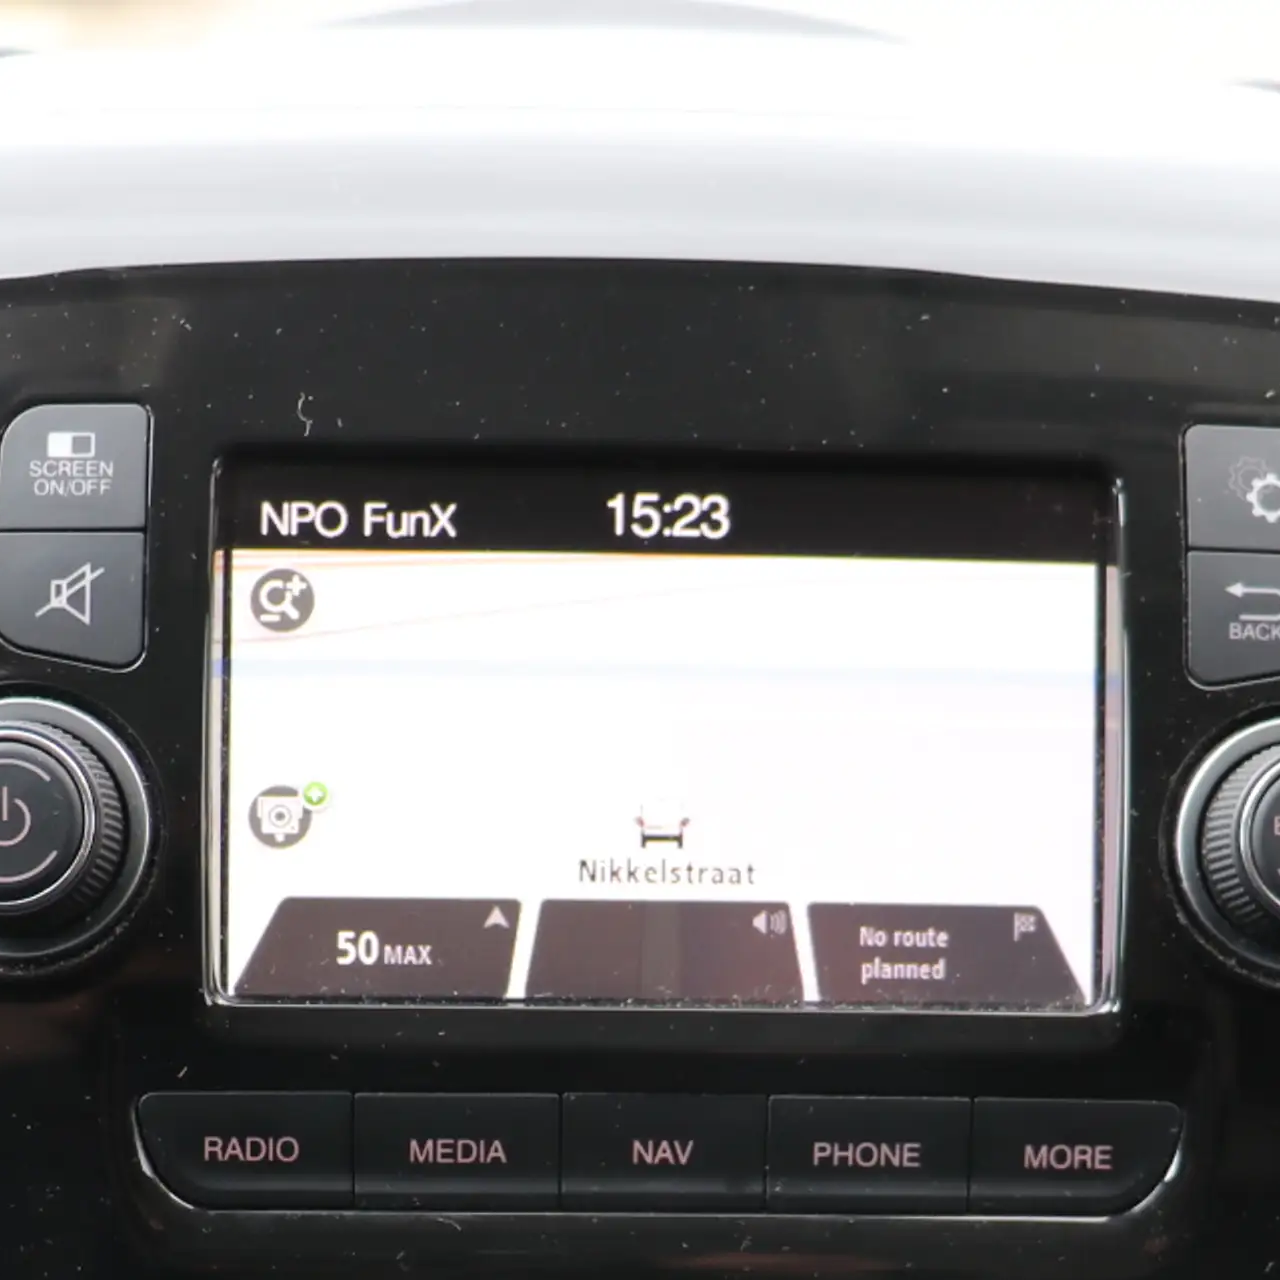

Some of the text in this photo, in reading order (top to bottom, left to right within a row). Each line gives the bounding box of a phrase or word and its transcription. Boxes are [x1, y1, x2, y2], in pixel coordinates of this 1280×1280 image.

[29, 461, 114, 479] SCREEN
[33, 478, 111, 496] ON/OFF
[260, 501, 457, 538] NPO FunX
[606, 492, 731, 539] 15:23
[578, 858, 756, 886] Nikkelstraat
[336, 931, 432, 966] 50 MAX
[859, 926, 949, 948] No route
[860, 957, 946, 982] planned
[204, 1136, 300, 1163] RADIO
[409, 1138, 507, 1164] MEDIA
[632, 1139, 694, 1165] NAV
[813, 1141, 921, 1168] PHONE
[1023, 1144, 1113, 1170] MORE
